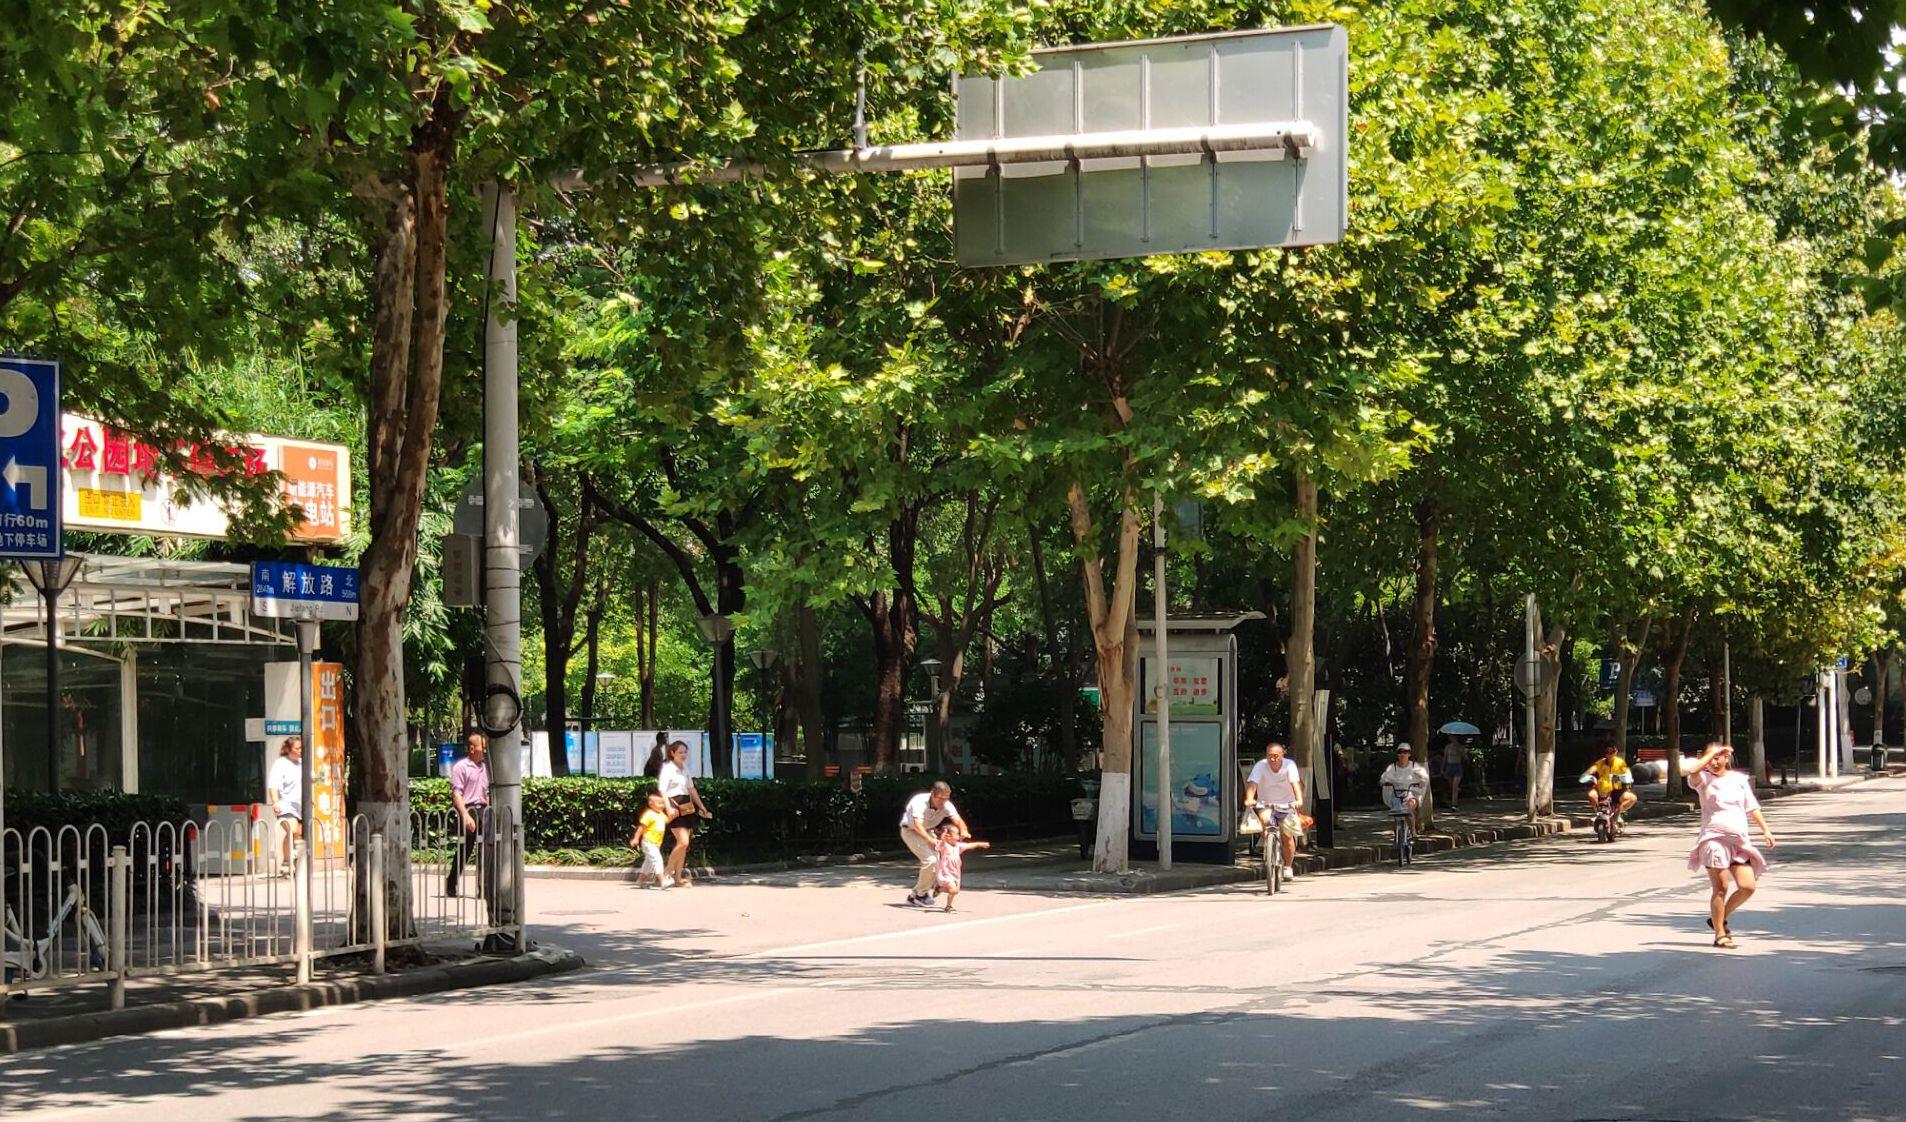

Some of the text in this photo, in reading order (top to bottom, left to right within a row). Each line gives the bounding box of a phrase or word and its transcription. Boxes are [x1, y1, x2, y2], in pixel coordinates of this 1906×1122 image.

[0, 512, 49, 529] 行60m
[261, 568, 270, 583] 南
[282, 570, 334, 597] 解放路
[345, 574, 354, 588] 北
[346, 606, 352, 617] N
[321, 670, 337, 730] 出口
